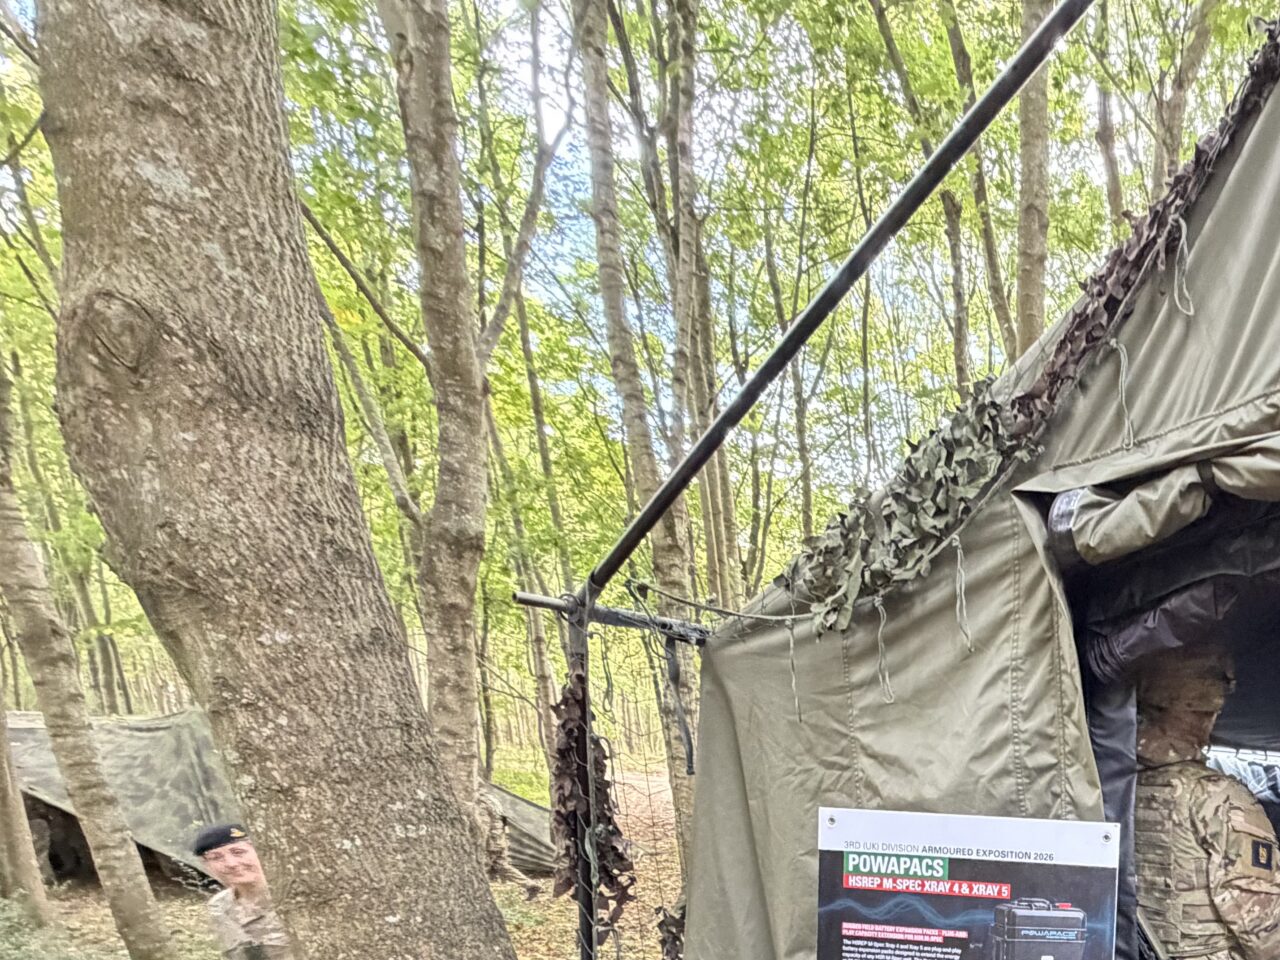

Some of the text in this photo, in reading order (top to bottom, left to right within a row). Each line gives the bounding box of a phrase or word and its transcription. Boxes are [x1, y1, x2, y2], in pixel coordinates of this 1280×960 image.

[844, 840, 1054, 861] 3RD (UK) DIVISION ARMOURED EXPOSITION 2026
[847, 853, 944, 877] POWAPACS
[847, 874, 1008, 897] HSREP M-SPEC XRAY 4 & XRAY 5
